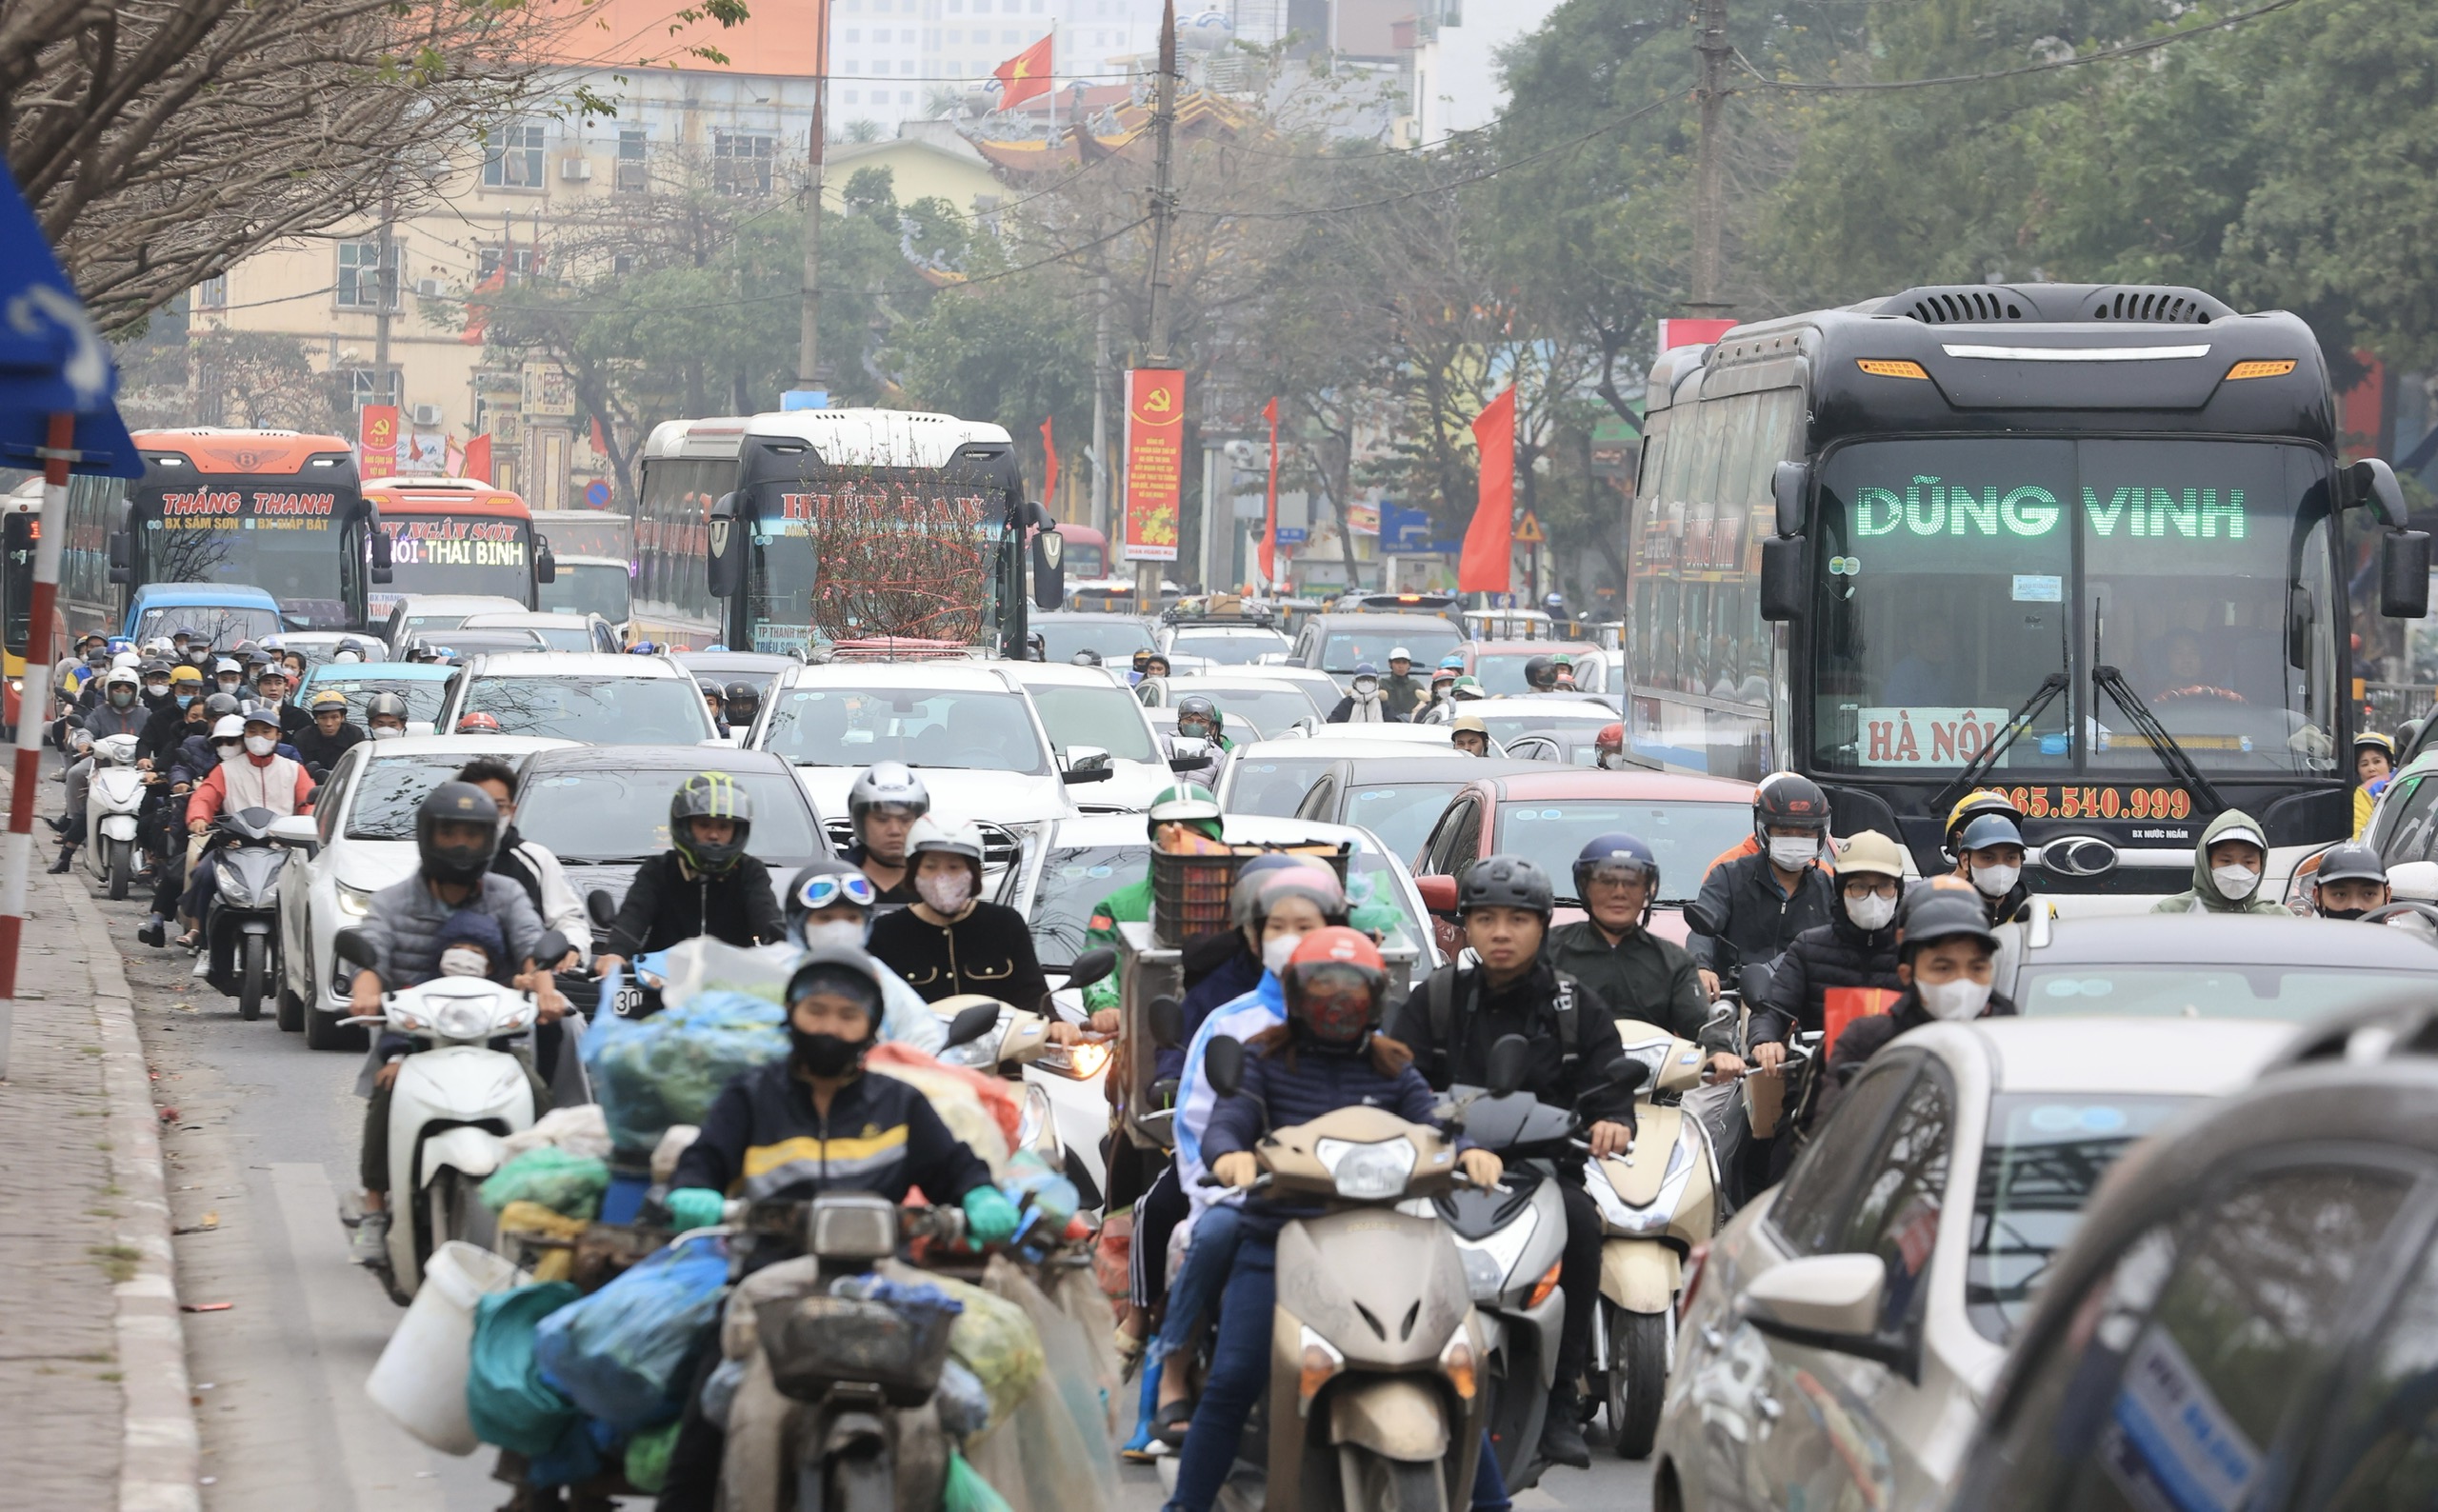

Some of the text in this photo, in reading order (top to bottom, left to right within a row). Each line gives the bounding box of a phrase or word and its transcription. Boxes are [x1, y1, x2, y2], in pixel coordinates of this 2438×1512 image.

[162, 484, 334, 515] THẮNG THANH
[1858, 475, 2245, 538] DŨNG VINH
[165, 517, 181, 529] BX
[214, 517, 239, 529] SƠN
[258, 518, 273, 529] BX
[307, 517, 329, 531] BÁT
[408, 516, 470, 540] NGÂN
[470, 521, 518, 542] SƠN
[758, 627, 768, 638] TP
[769, 627, 794, 638] THANH
[1868, 710, 1920, 762] HÀ
[1974, 786, 2190, 820] 65.540.999
[2132, 829, 2143, 838] BX
